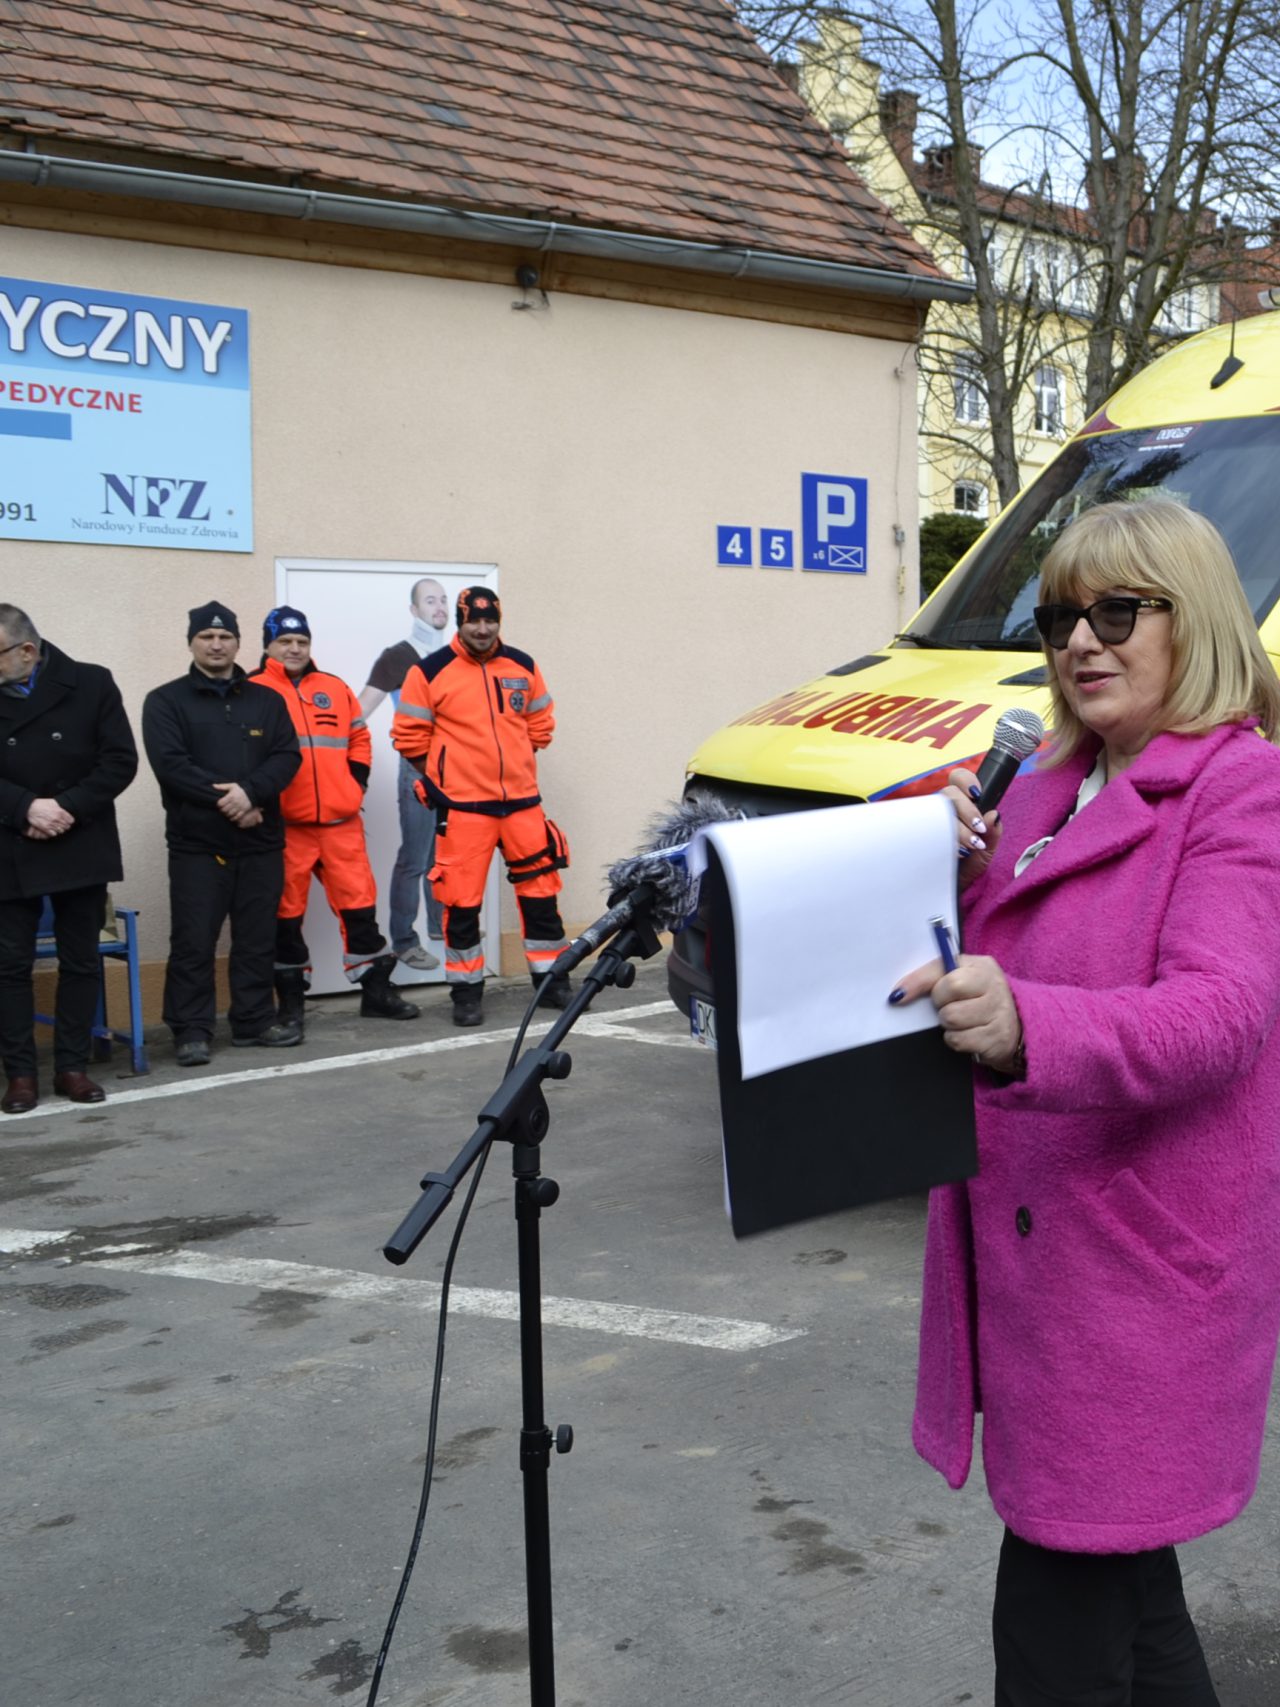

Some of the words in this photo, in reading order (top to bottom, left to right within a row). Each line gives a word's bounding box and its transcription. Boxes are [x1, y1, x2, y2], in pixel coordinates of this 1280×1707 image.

[99, 472, 211, 521] NFZ
[816, 481, 856, 543] P
[71, 517, 135, 535] Narodowy
[138, 522, 188, 536] Fundusz
[191, 525, 239, 539] Zdrowia
[726, 532, 744, 559] 4
[770, 536, 786, 561] 5
